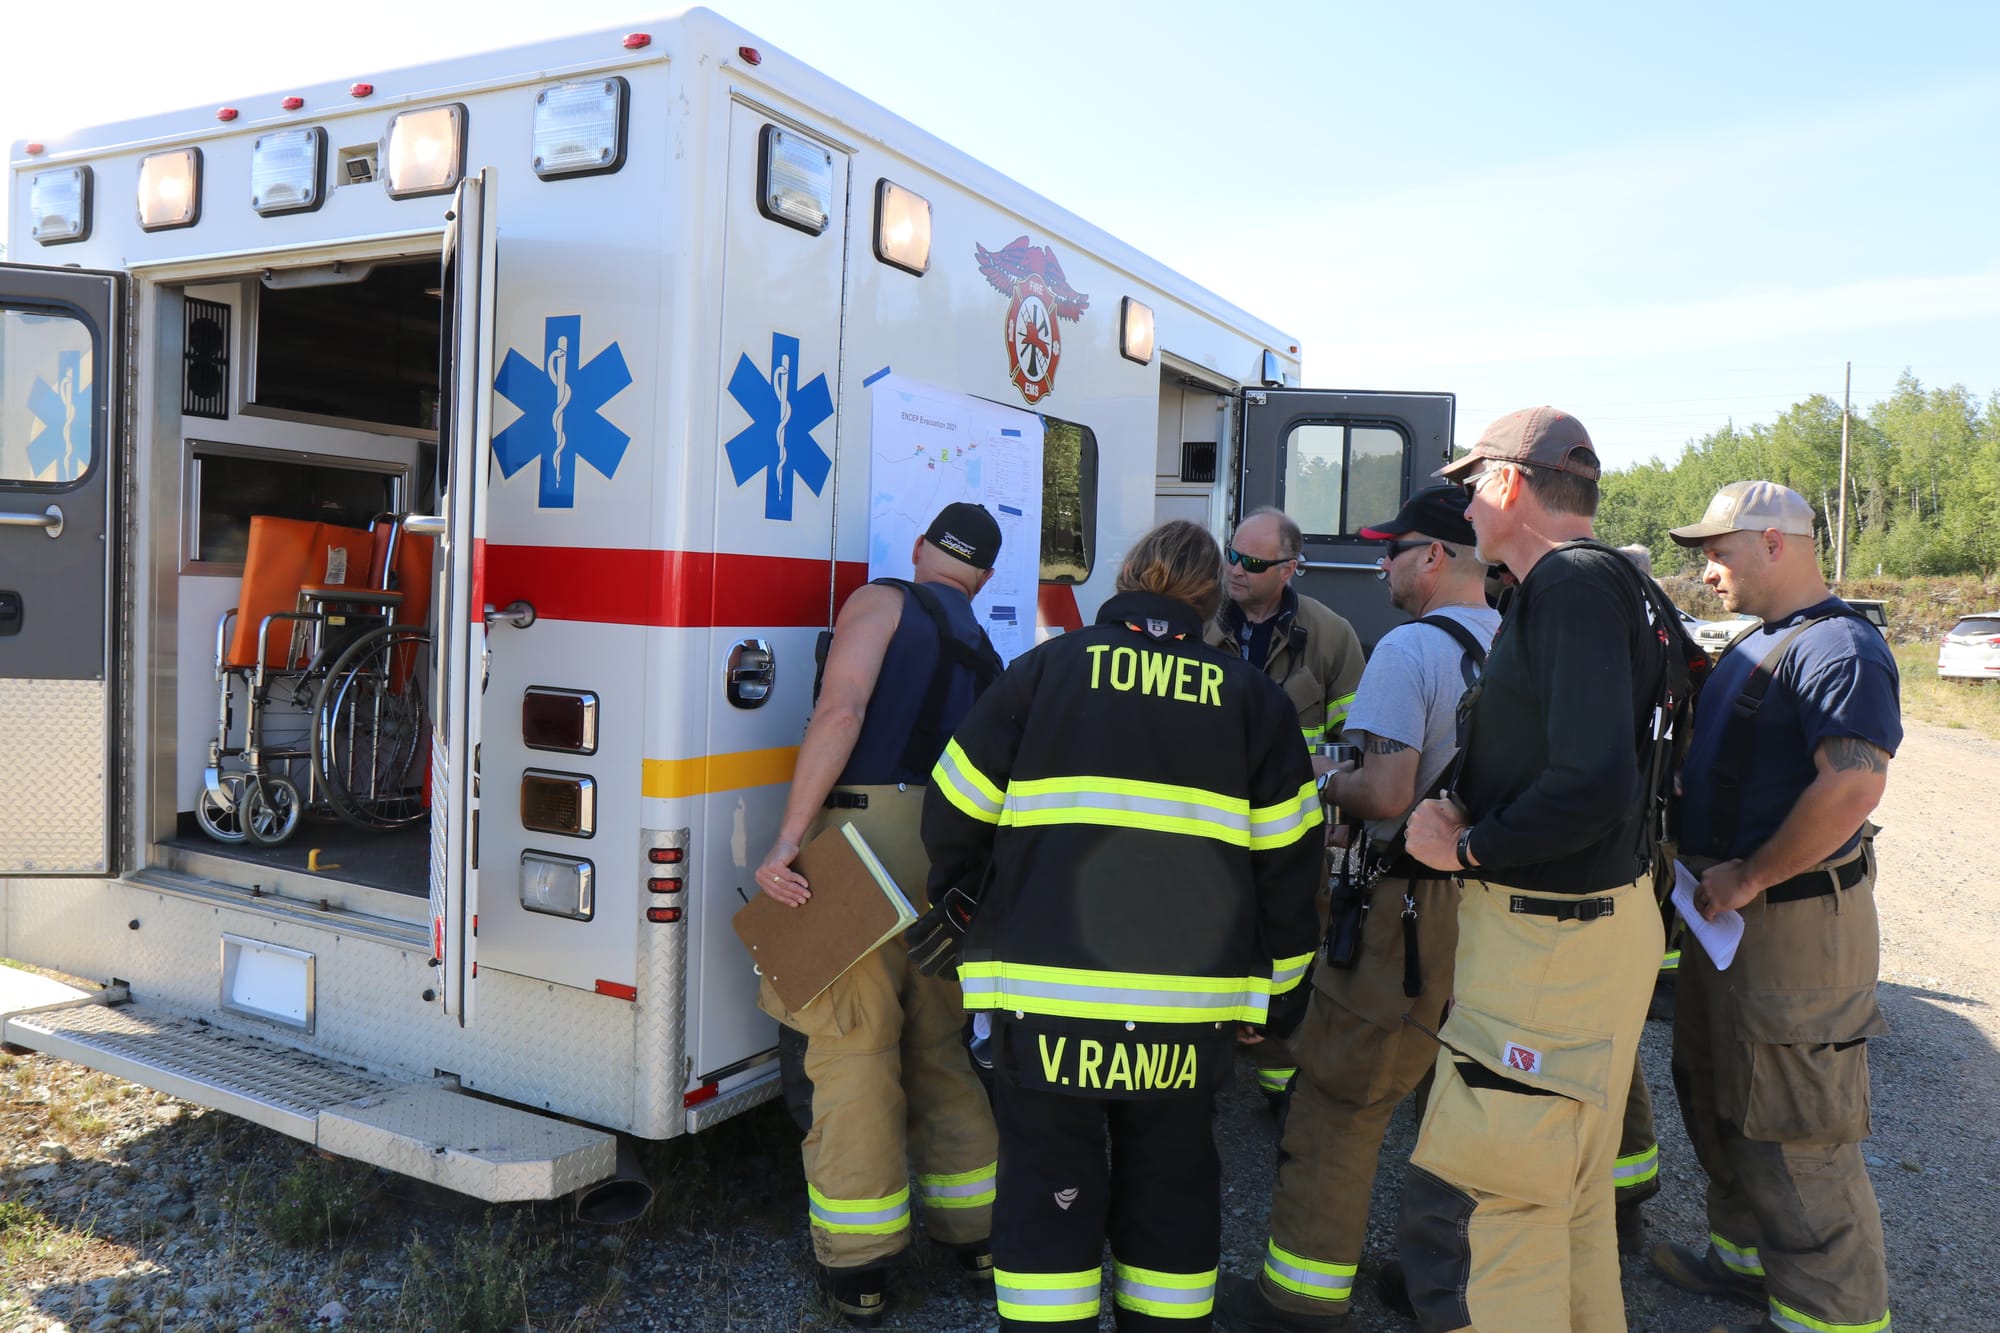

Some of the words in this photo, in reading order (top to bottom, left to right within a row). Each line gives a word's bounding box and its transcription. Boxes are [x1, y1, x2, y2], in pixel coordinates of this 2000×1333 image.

[1029, 280, 1043, 295] FIRE
[1025, 382, 1039, 397] EMS
[919, 416, 946, 430] Evacuation
[1086, 644, 1224, 707] TOWER
[1038, 1034, 1070, 1085] V.
[1078, 1039, 1197, 1091] RANUA
